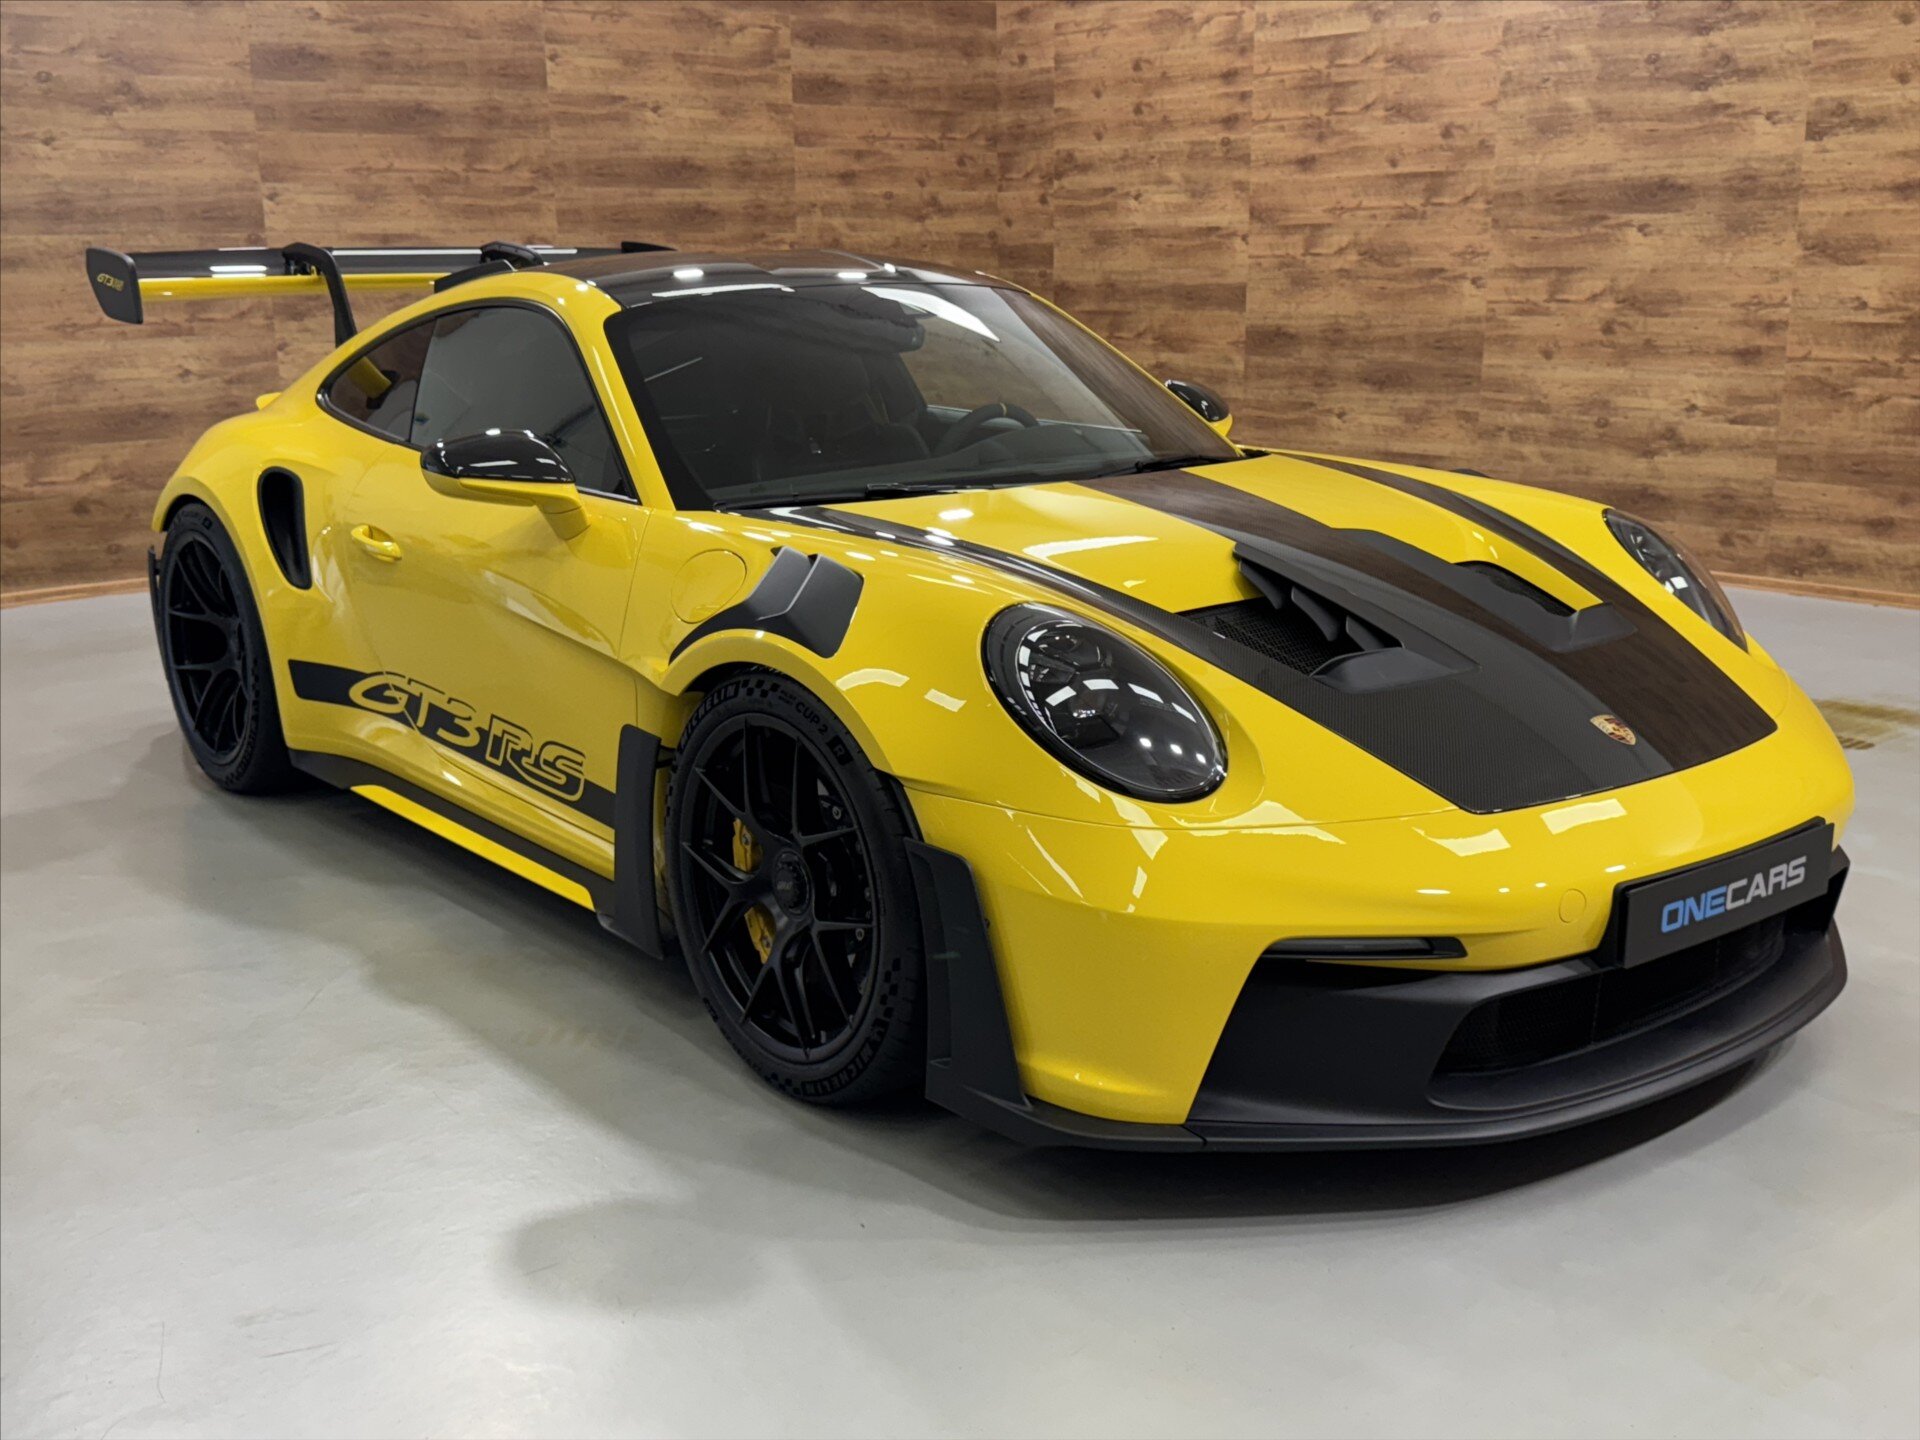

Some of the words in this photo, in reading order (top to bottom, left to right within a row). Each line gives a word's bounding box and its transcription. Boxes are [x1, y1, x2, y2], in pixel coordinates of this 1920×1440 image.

[680, 683, 736, 750] MICHELIN
[795, 701, 820, 724] CUP
[818, 723, 829, 736] 2
[1661, 856, 1807, 934] ONECARS
